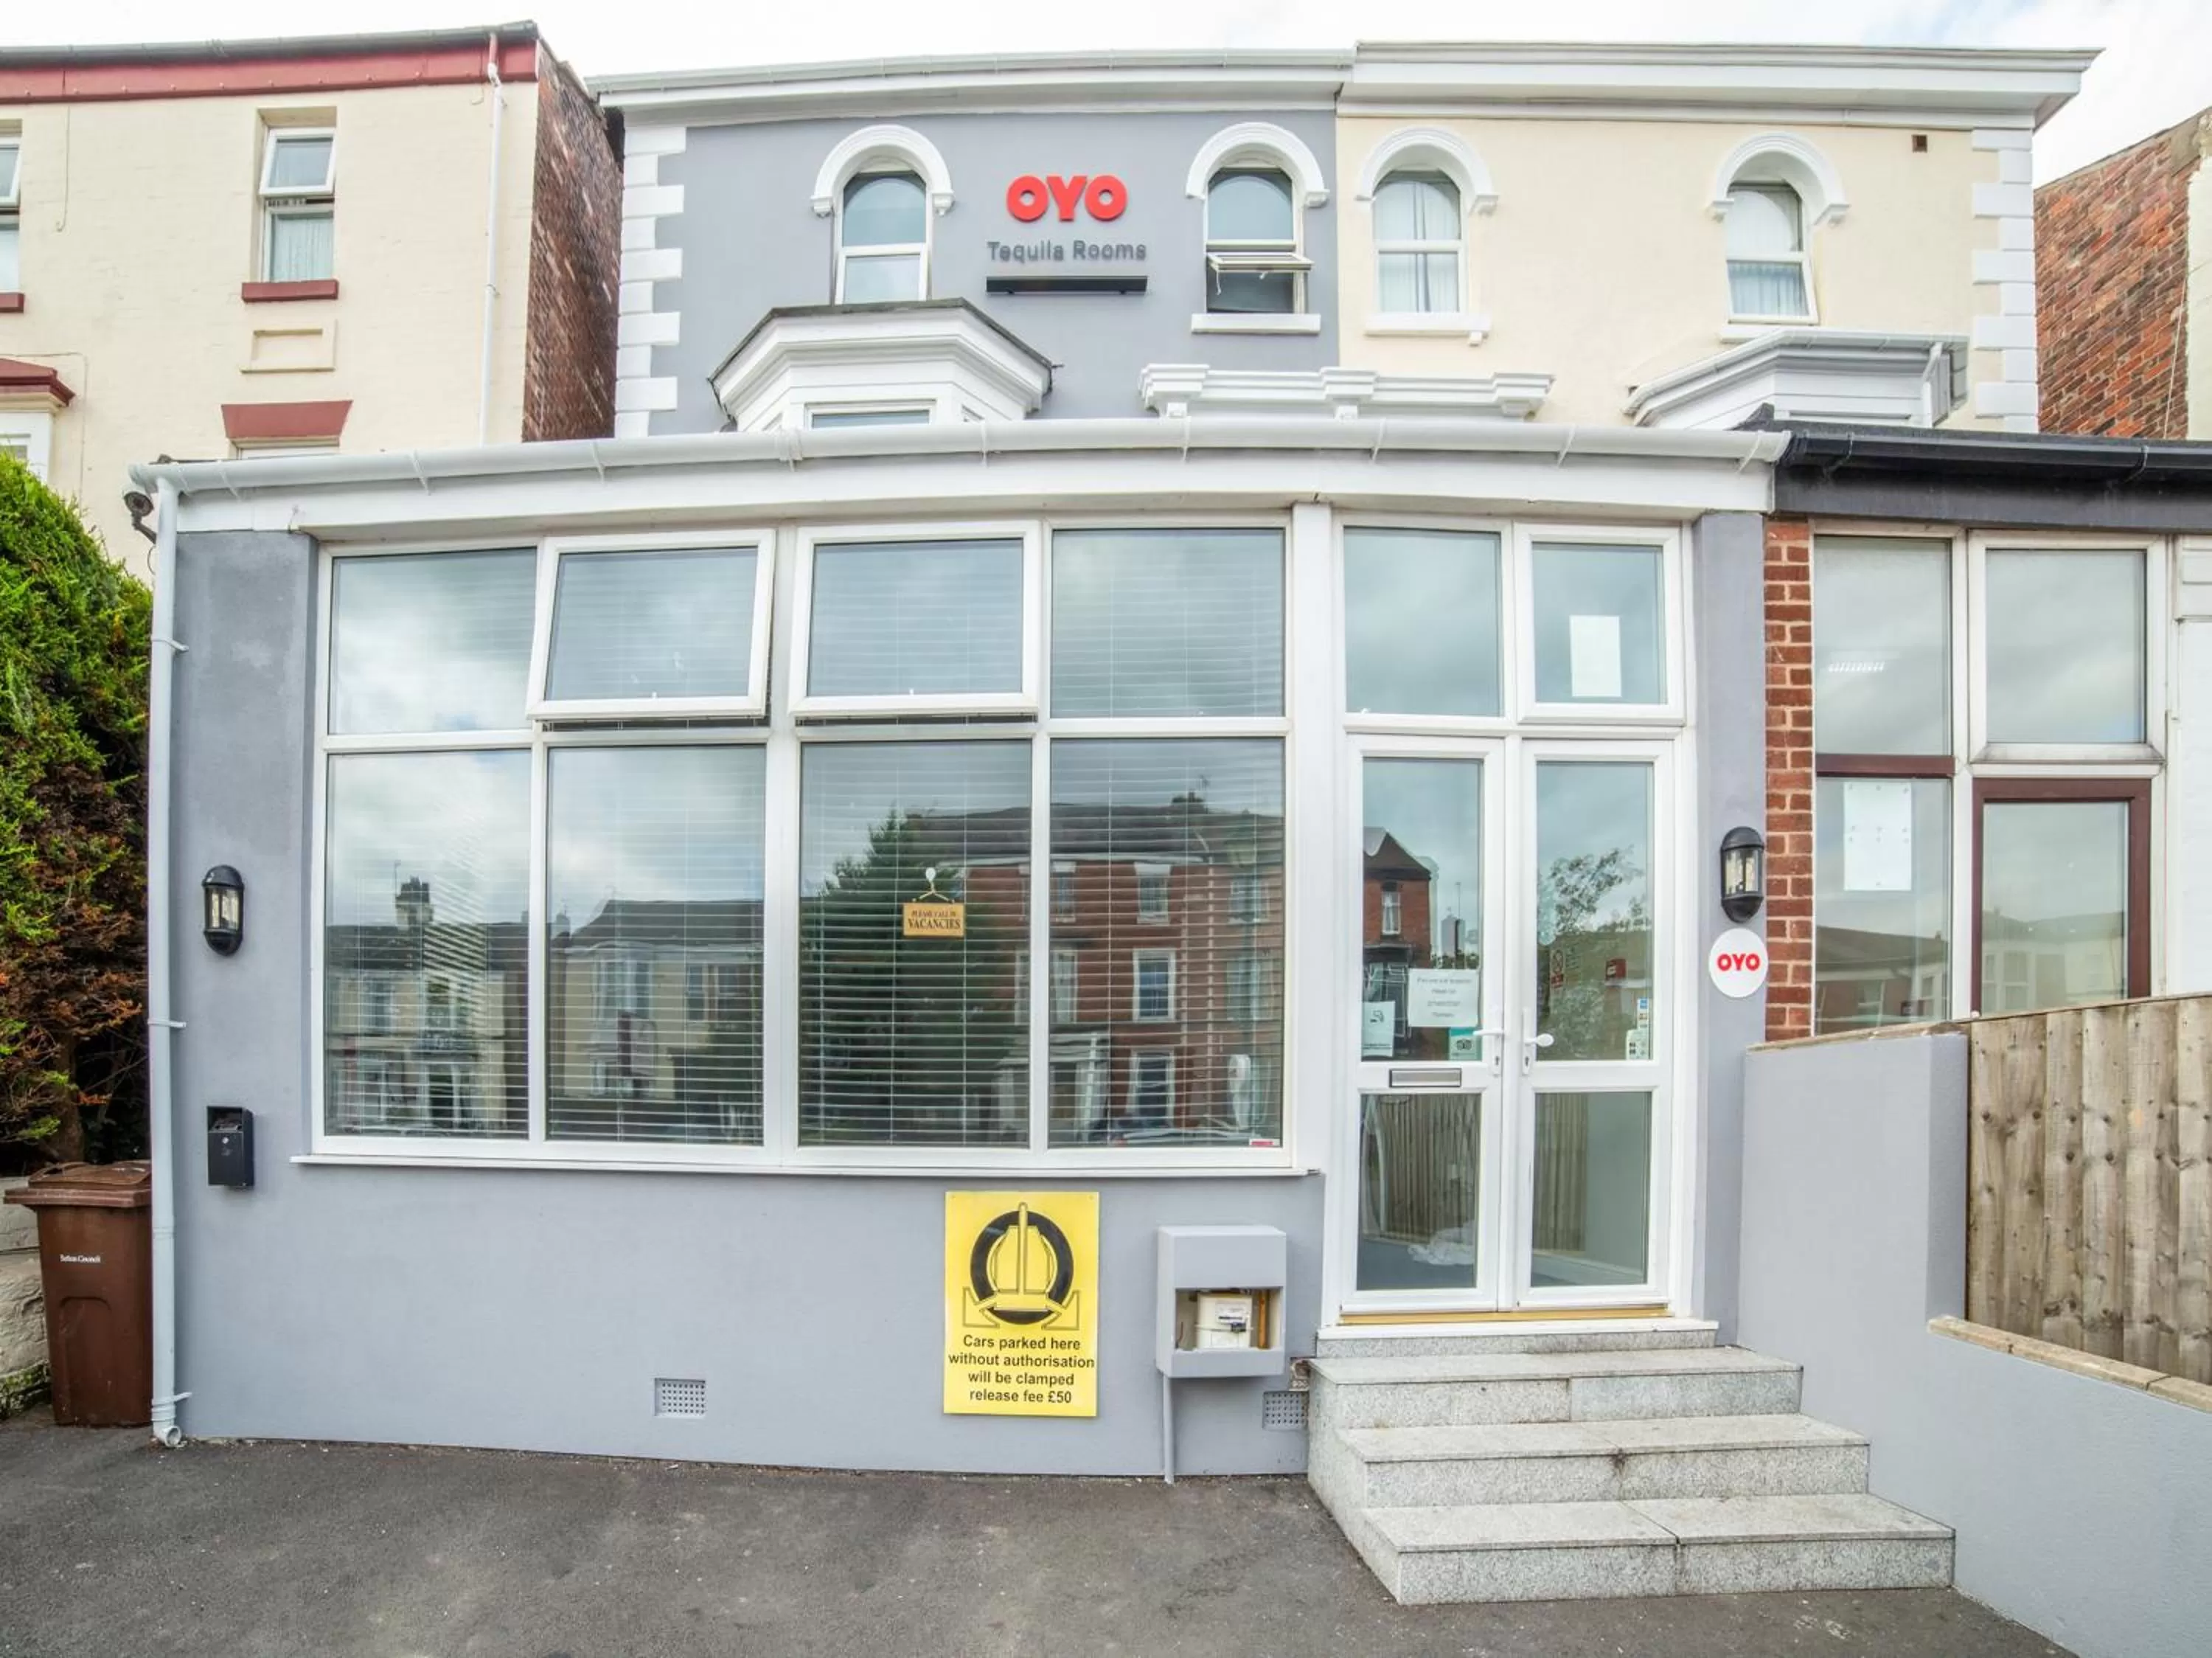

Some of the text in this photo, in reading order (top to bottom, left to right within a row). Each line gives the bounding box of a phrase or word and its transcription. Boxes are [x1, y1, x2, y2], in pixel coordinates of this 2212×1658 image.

[1006, 175, 1127, 222] OYO
[987, 240, 1147, 264] Tequila Rooms
[908, 918, 961, 929] VACANCIES
[1717, 953, 1761, 971] OYO
[963, 1334, 1081, 1351] Cars parked here
[948, 1352, 1095, 1368] without authorisation
[968, 1370, 1074, 1387] will be clamped
[970, 1389, 1072, 1404] release fee £50
